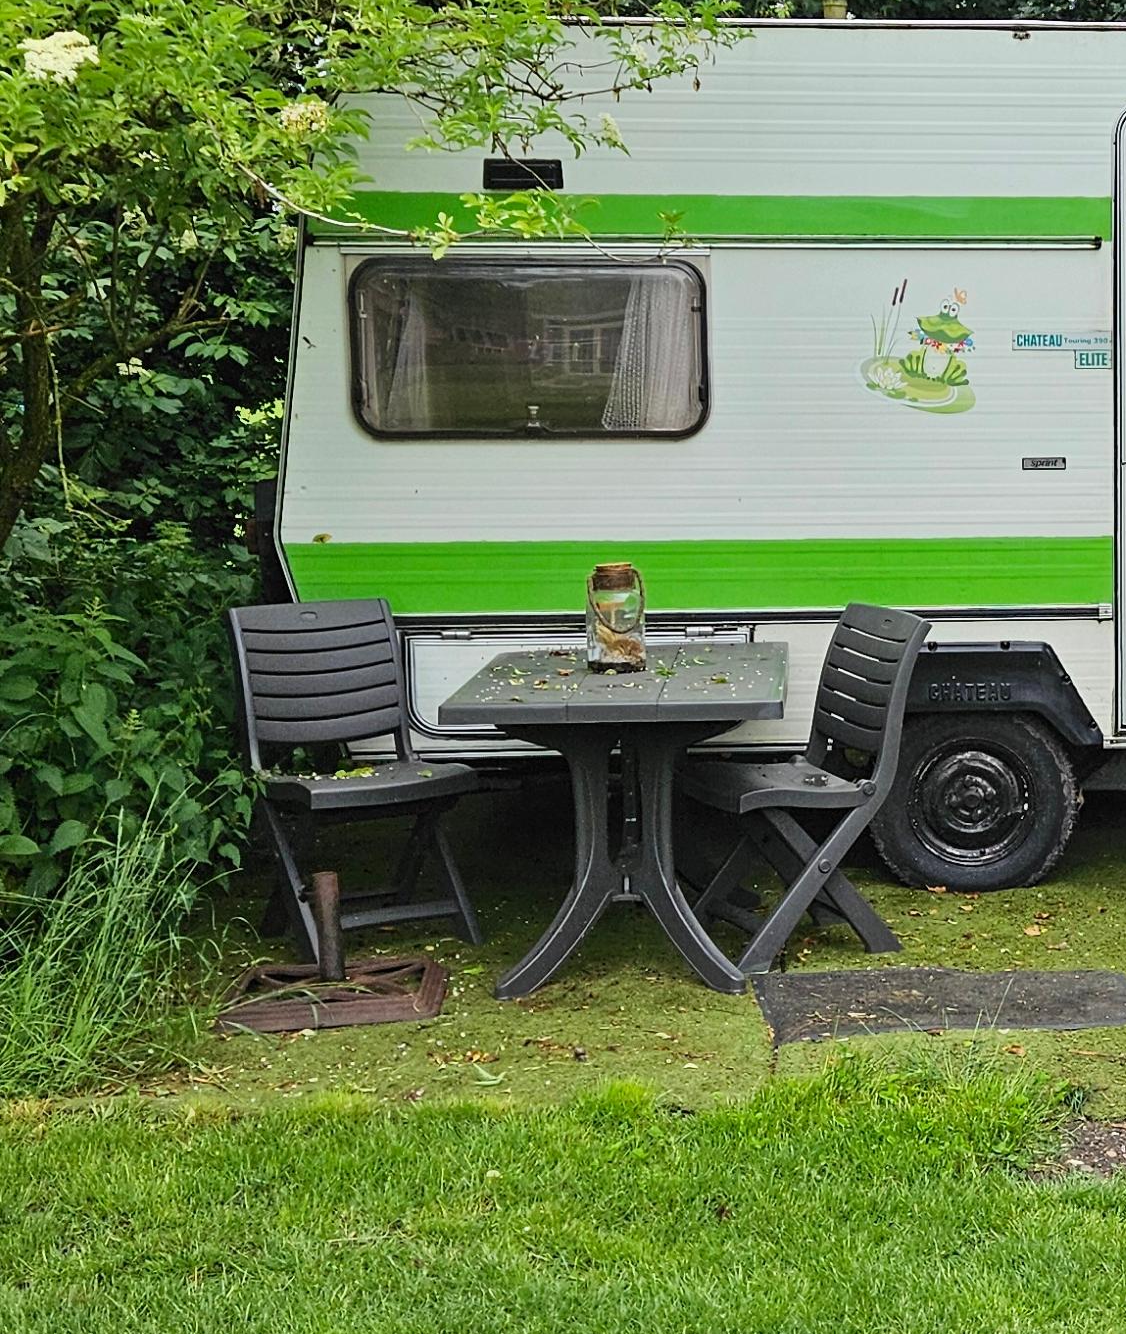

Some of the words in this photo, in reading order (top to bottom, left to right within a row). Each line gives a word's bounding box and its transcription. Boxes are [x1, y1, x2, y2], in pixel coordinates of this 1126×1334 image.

[1016, 334, 1063, 347] CHATEAU
[1064, 337, 1092, 345] Touring
[1079, 352, 1108, 366] ELITE
[1030, 459, 1058, 468] sprint
[928, 682, 1012, 701] CHATEAU
